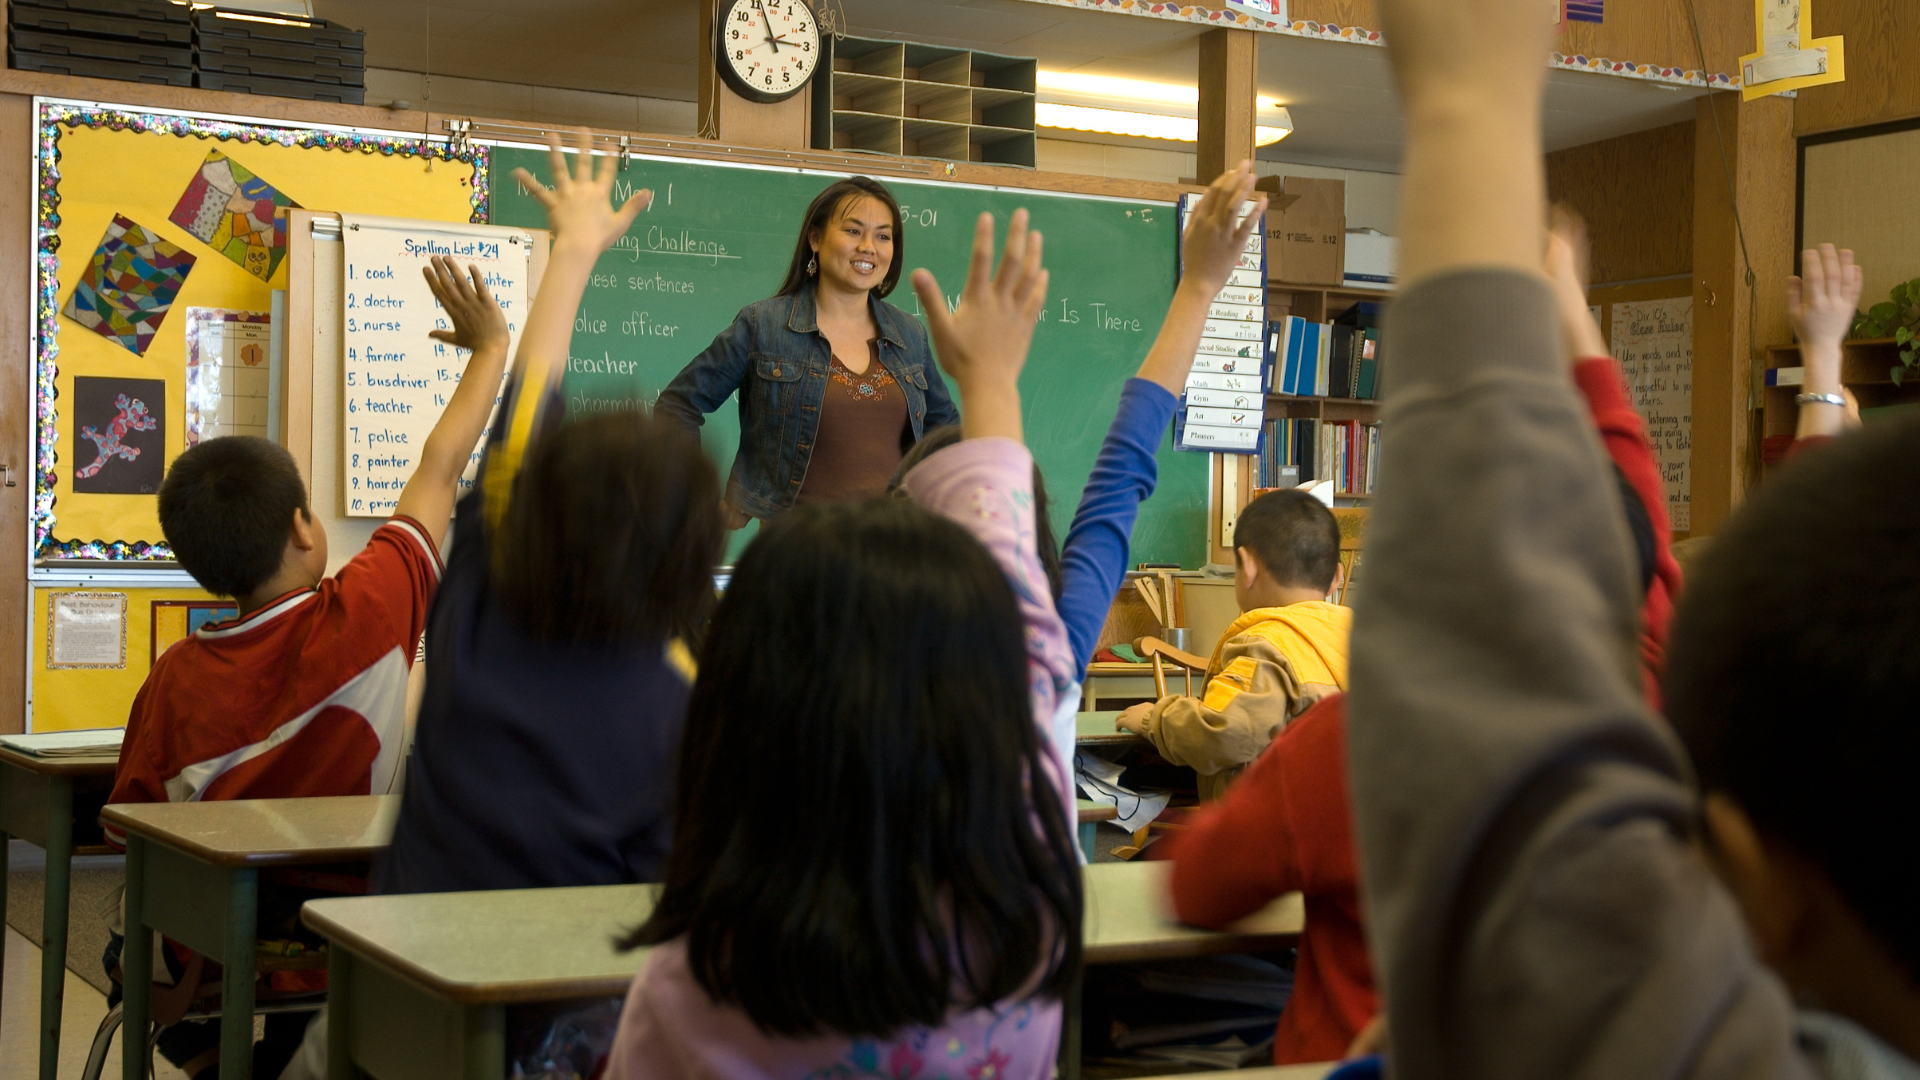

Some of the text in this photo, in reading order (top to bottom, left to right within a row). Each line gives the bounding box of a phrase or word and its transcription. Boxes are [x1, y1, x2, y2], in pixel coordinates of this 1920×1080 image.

[768, 0, 780, 8] 12
[736, 11, 749, 22] 10
[788, 6, 793, 16] 1
[799, 22, 806, 32] 2
[732, 30, 739, 40] 9
[803, 42, 810, 52] 3
[736, 50, 743, 60] 8
[748, 66, 755, 76] 7
[796, 60, 803, 70] 4
[765, 75, 772, 85] 6
[783, 72, 790, 82] 5
[668, 182, 672, 206] 1
[1272, 230, 1281, 239] 12
[1328, 235, 1337, 244] 12
[404, 238, 450, 258] Spelling
[454, 241, 476, 256] List
[611, 226, 728, 266] ing Challenge
[350, 264, 394, 280] 1. cook
[586, 271, 695, 294] hese sentences
[348, 293, 405, 309] 2. doctor
[1223, 292, 1246, 301] Program
[1058, 298, 1080, 324] Is
[1088, 303, 1142, 332] There
[1216, 309, 1238, 318] Reading
[348, 318, 401, 332] 3. nurse
[436, 318, 450, 330] 13.
[575, 308, 679, 337] olice officer
[348, 346, 406, 363] 4. farmer
[434, 344, 450, 357] 14.
[1622, 348, 1636, 361] Use
[1642, 346, 1662, 360] words
[1666, 343, 1681, 358] and
[566, 351, 638, 375] teacher
[1622, 363, 1639, 379] body
[1643, 362, 1650, 373] to
[1654, 360, 1670, 372] solve
[347, 372, 430, 388] 5. busdriver
[437, 369, 452, 381] 15.
[1636, 378, 1666, 394] respectful
[1673, 380, 1679, 391] to
[434, 394, 449, 406] 16.
[1194, 395, 1208, 403] Gym
[349, 398, 413, 414] 6. teacher
[1648, 411, 1678, 428] listening
[350, 427, 408, 449] 7. police
[1190, 431, 1215, 440] Planners
[1650, 426, 1662, 437] and
[1665, 430, 1682, 440] using
[1647, 437, 1691, 455] body to liste
[352, 454, 410, 472] 8. painter
[1668, 461, 1685, 470] your
[352, 477, 406, 490] 9. hairdr
[1662, 471, 1684, 484] FUN!
[1669, 490, 1680, 502] and
[351, 497, 399, 514] 10. princ
